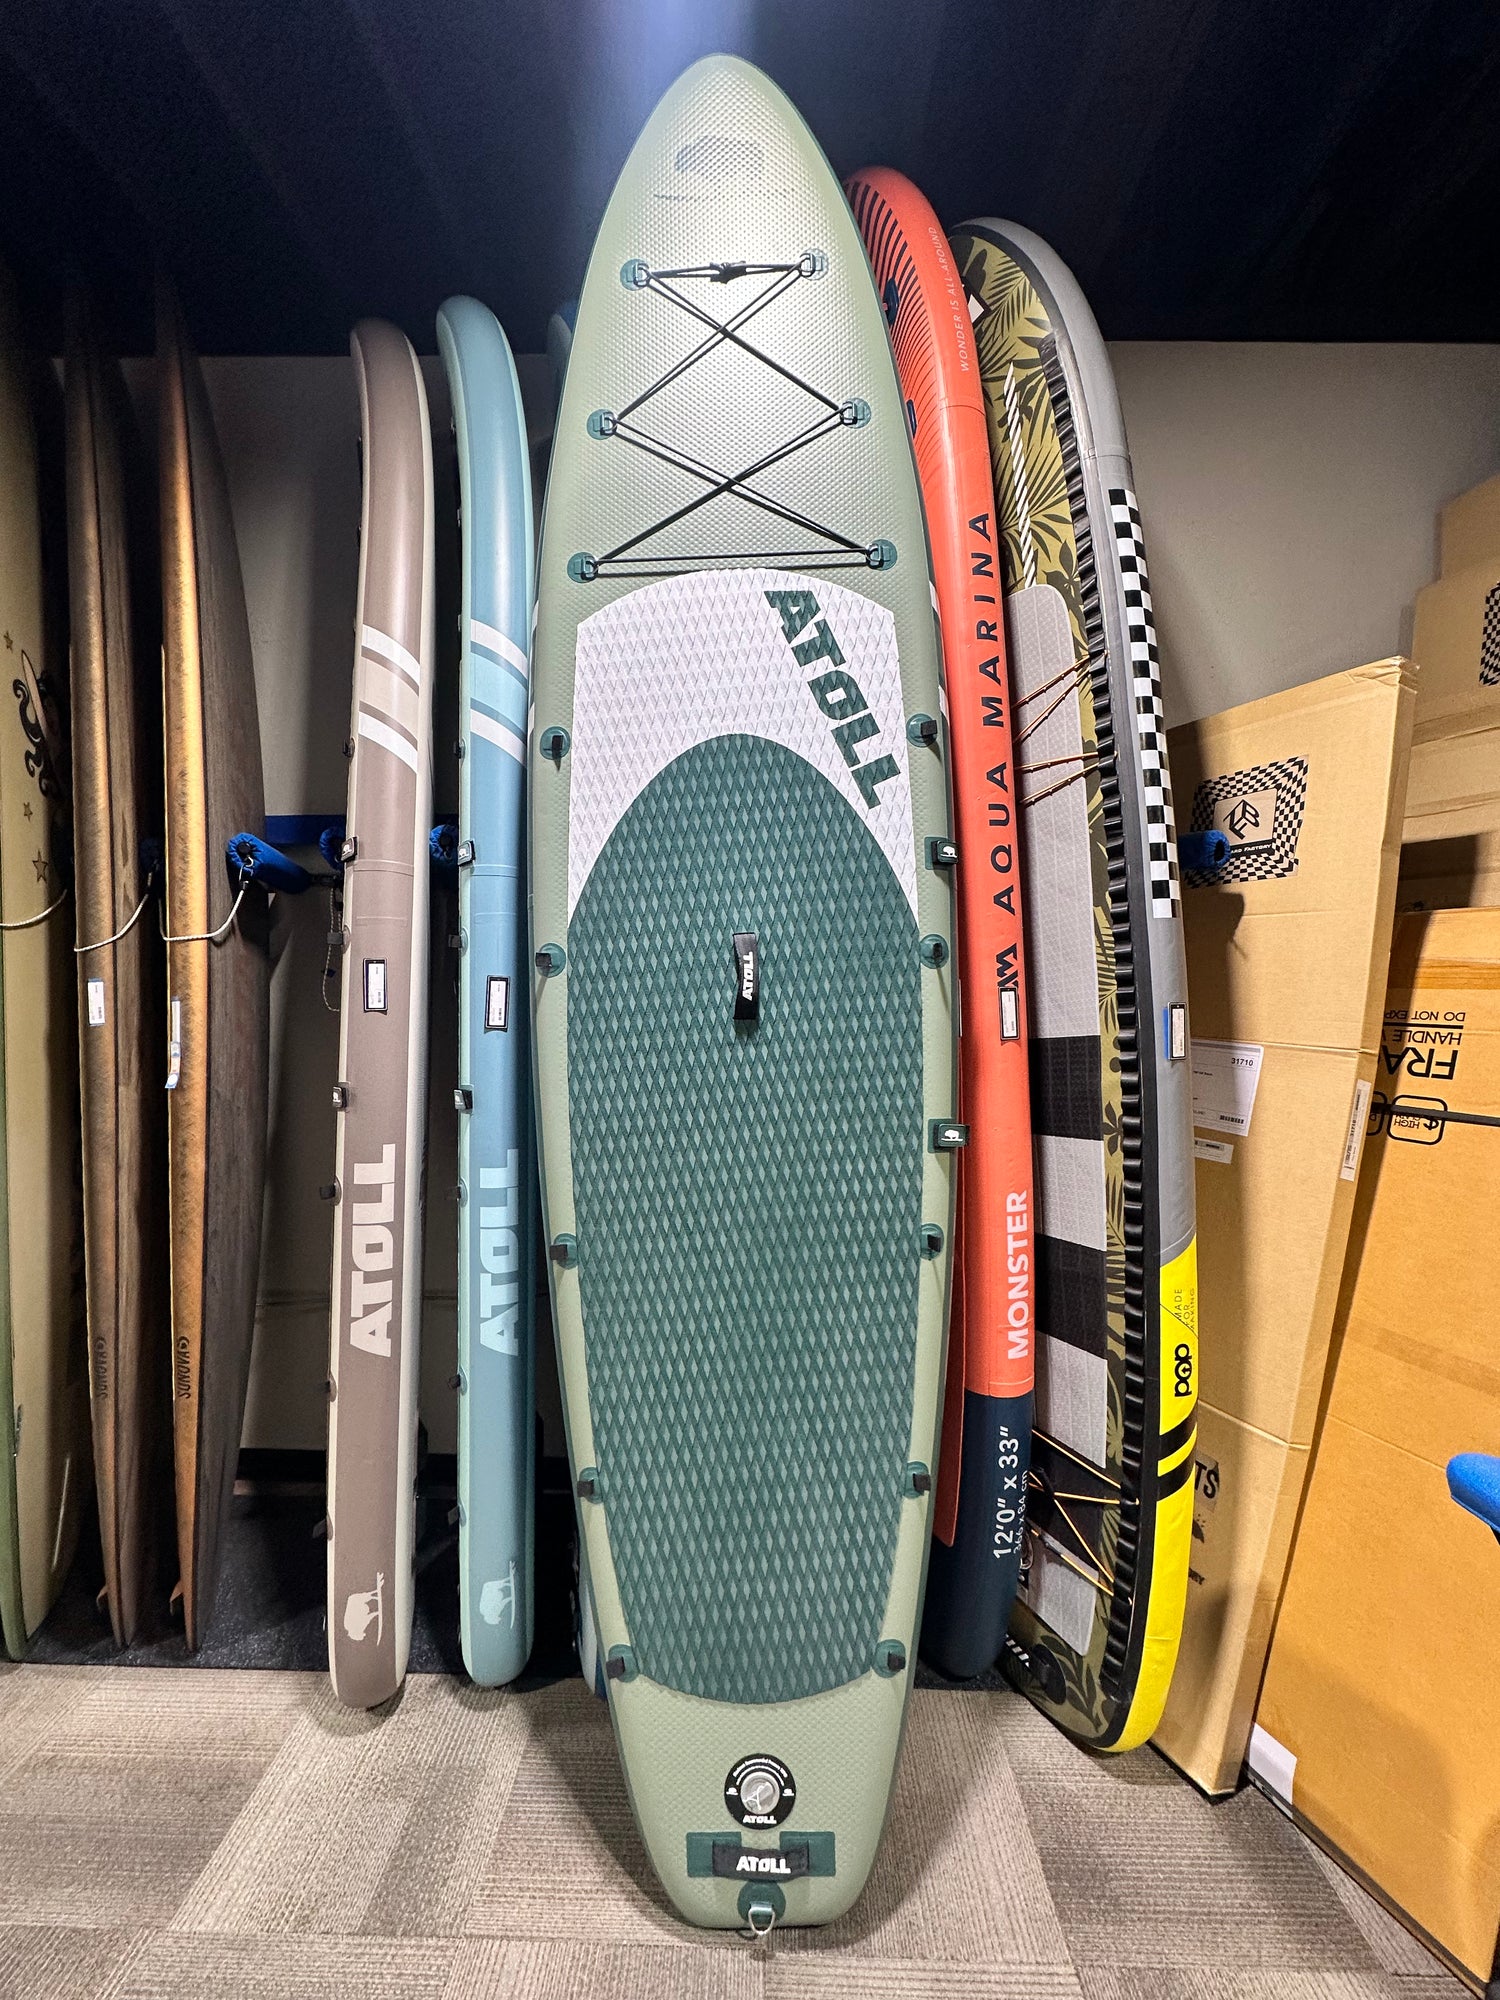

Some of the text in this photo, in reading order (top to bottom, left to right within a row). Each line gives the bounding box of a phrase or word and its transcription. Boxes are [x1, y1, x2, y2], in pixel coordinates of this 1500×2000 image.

[927, 226, 969, 372] WONDER IS ALL-AROUND
[763, 590, 901, 810] ATOLL
[968, 512, 1016, 916] AQUA MARINA
[742, 951, 754, 1001] ATOLL
[1410, 1010, 1439, 1021] NOT
[1443, 1011, 1466, 1022] DO
[1392, 1028, 1463, 1046] HANDLE
[1231, 1057, 1254, 1067] 31710
[1393, 1119, 1420, 1130] HIGH
[350, 1143, 396, 1358] ATOLL
[479, 1149, 519, 1357] ATOLL
[1006, 1189, 1029, 1361] MONSTER
[1174, 1289, 1182, 1321] MADE
[176, 1350, 191, 1400] SUNOVA
[992, 1425, 1019, 1560] 12'0" x 33"
[1020, 1470, 1029, 1492] cm
[1017, 1494, 1027, 1515] 84
[743, 1814, 777, 1825] ATOLL
[736, 1855, 792, 1874] ATOLL
